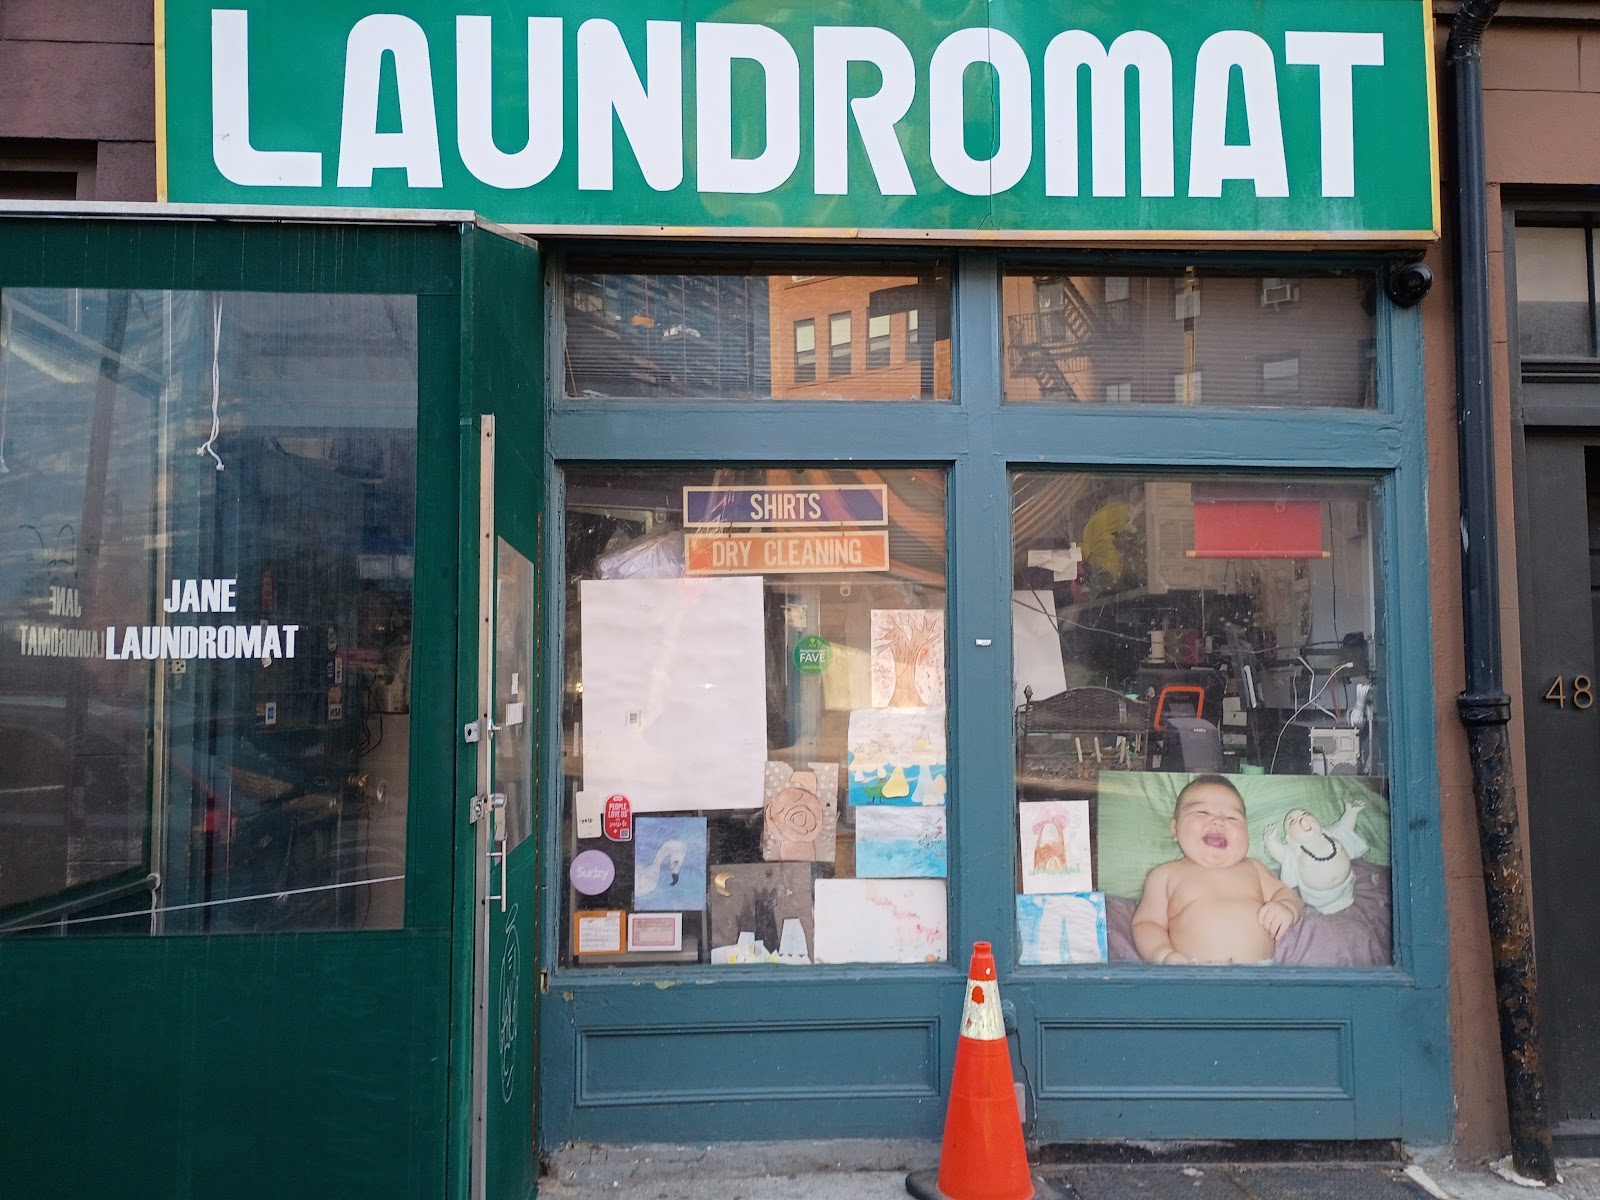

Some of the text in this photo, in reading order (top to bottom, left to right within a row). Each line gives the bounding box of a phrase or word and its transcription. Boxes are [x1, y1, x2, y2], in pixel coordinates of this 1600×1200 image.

[211, 8, 1385, 198] LAUNDROMAT
[750, 492, 822, 520] SHIRTS
[712, 538, 862, 567] DRY CLEANING
[163, 578, 237, 613] JANE
[105, 625, 299, 660] LAUNDROMAT
[799, 652, 826, 663] FAVE
[1545, 675, 1593, 709] 48
[329, 707, 342, 717] VISA
[608, 802, 627, 811] PEOPLE
[608, 810, 620, 819] LOVE
